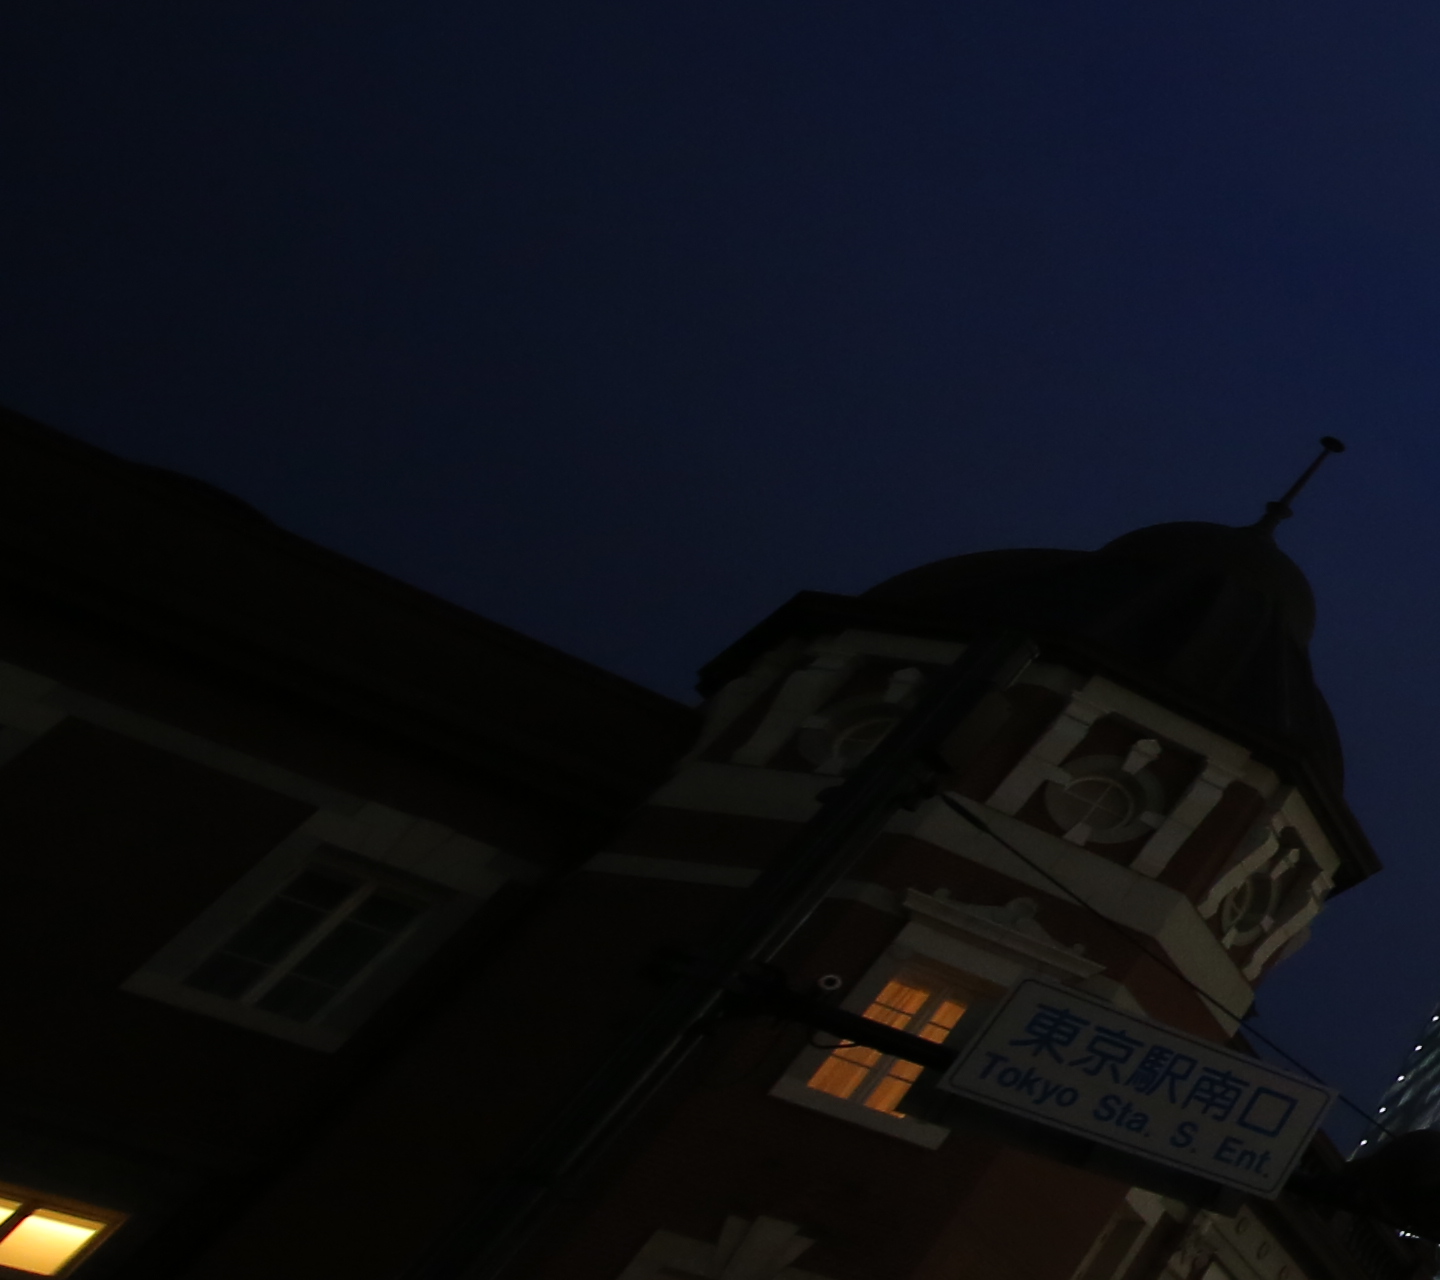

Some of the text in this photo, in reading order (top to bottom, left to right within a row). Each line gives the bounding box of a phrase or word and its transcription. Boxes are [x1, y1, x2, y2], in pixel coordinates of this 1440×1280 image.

[977, 1052, 1272, 1179] Tokyo Sta. S. Ent.
[1009, 1002, 1299, 1139] 東京駅南口
